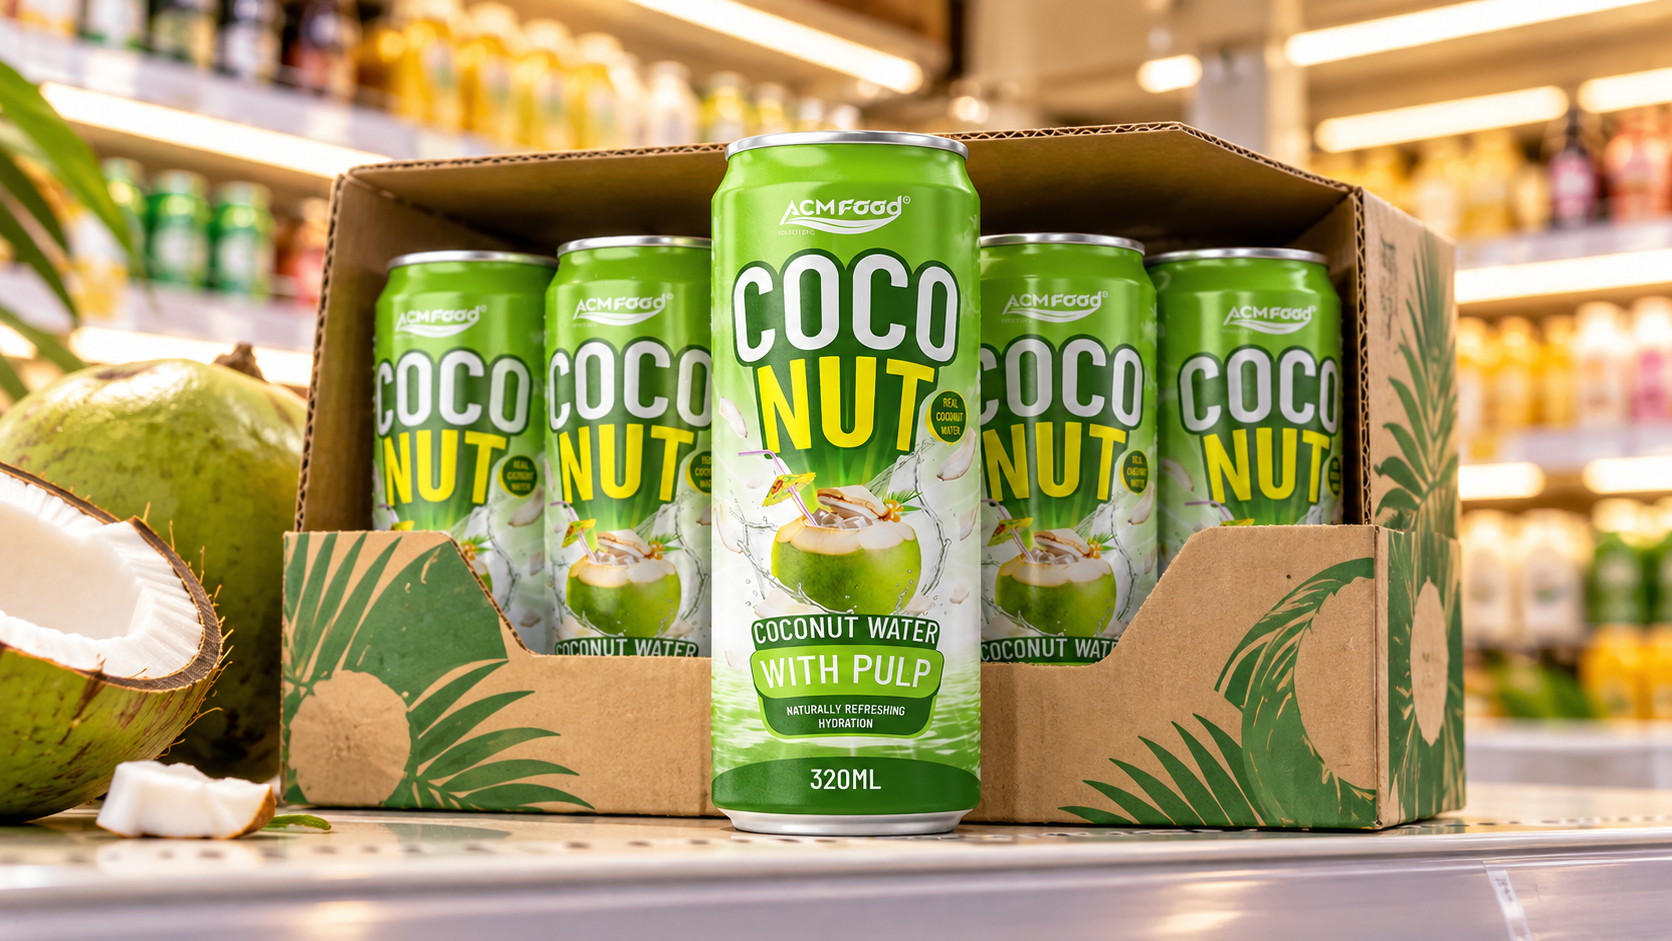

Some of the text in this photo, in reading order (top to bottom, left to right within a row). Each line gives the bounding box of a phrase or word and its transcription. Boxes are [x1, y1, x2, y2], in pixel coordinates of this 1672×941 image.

[733, 253, 958, 363] COCO
[377, 350, 531, 436] COCO
[549, 340, 712, 430] COCO
[757, 355, 935, 454] NUT
[942, 397, 959, 409] REAL
[1179, 348, 1339, 434] COCO
[384, 429, 507, 507] NUT
[559, 423, 695, 504] NUT
[982, 421, 1127, 502] NUT
[1203, 427, 1331, 504] NUT
[556, 639, 697, 657] COCONUT WATER
[753, 616, 939, 645] COCONUT WATER
[981, 638, 1118, 662] COCONUT WAT
[760, 654, 931, 689] WITH PULP
[786, 704, 906, 716] NATURALLY REFRESHING
[818, 718, 874, 729] HYDRATION
[810, 768, 882, 790] 320ML
